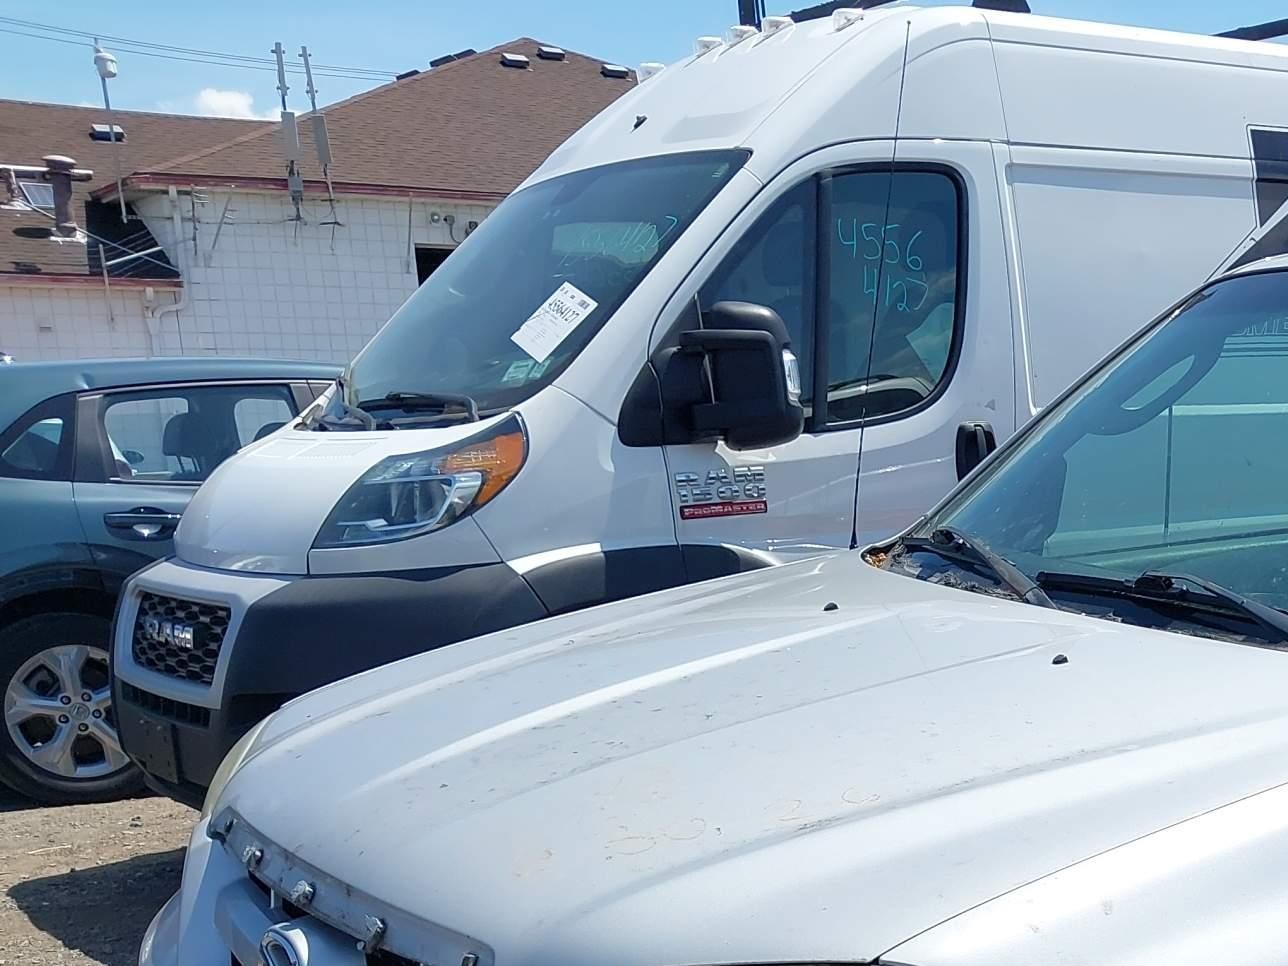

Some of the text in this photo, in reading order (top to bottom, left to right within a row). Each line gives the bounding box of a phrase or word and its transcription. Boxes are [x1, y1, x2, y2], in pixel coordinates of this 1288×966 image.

[837, 217, 923, 271] 4556
[863, 264, 929, 313] 4127
[674, 465, 765, 487] RAM
[683, 503, 766, 516] PROMASTER
[145, 618, 194, 649] RAM
